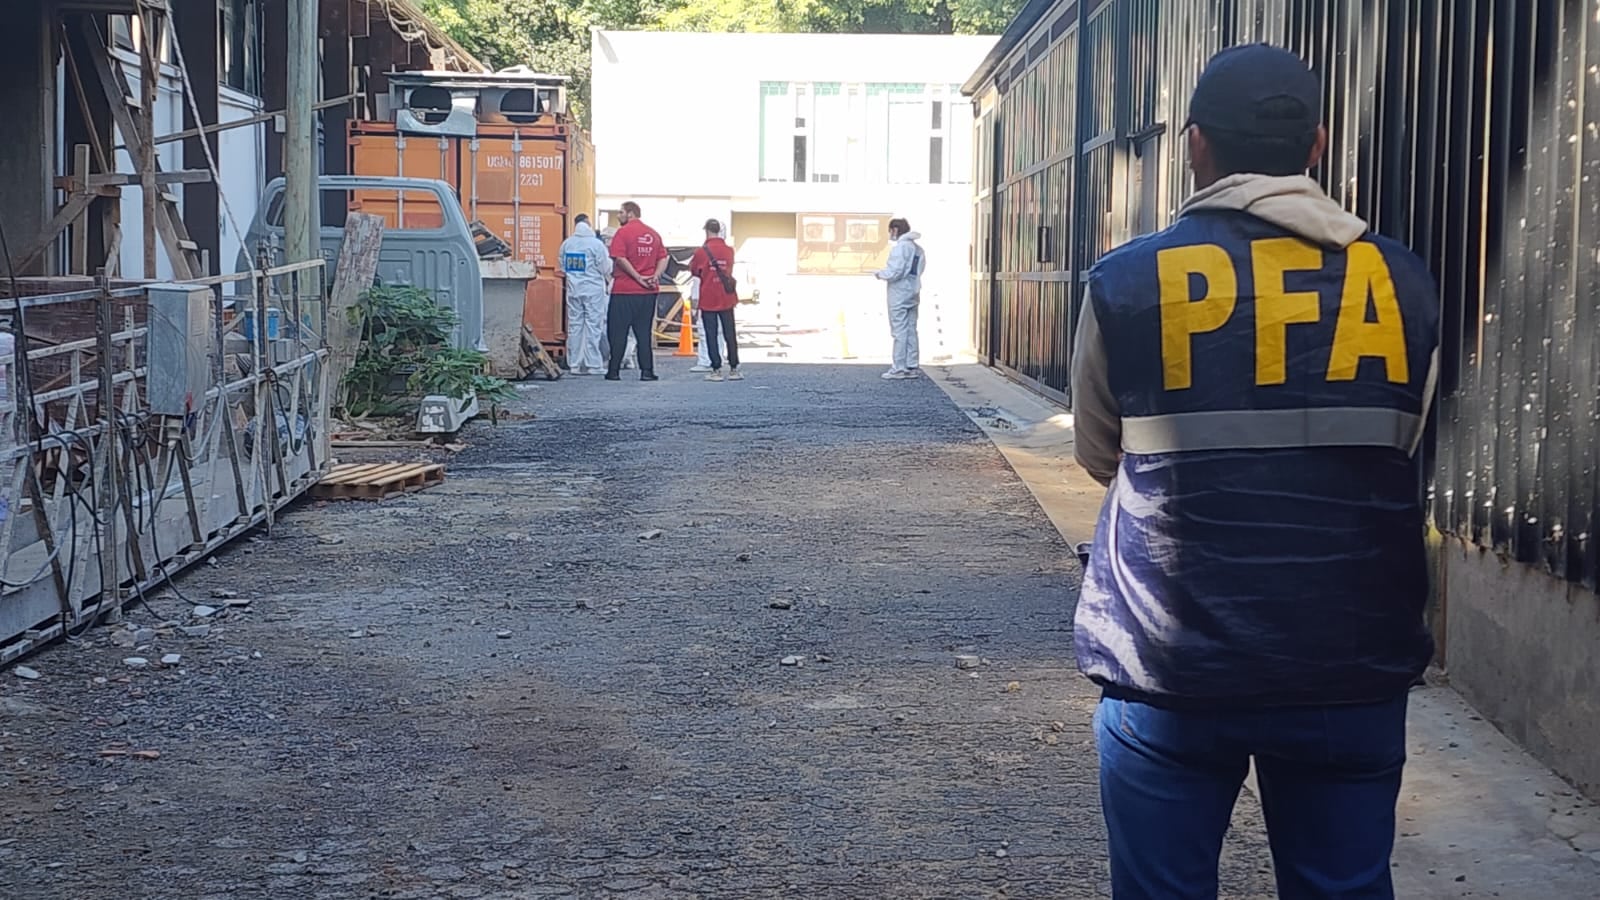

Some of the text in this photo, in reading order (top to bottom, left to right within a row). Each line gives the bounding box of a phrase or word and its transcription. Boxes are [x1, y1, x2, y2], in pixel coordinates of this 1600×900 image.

[520, 155, 563, 169] 8615017
[520, 173, 543, 186] 22G1
[566, 256, 585, 269] PFA
[1157, 237, 1409, 391] PFA
